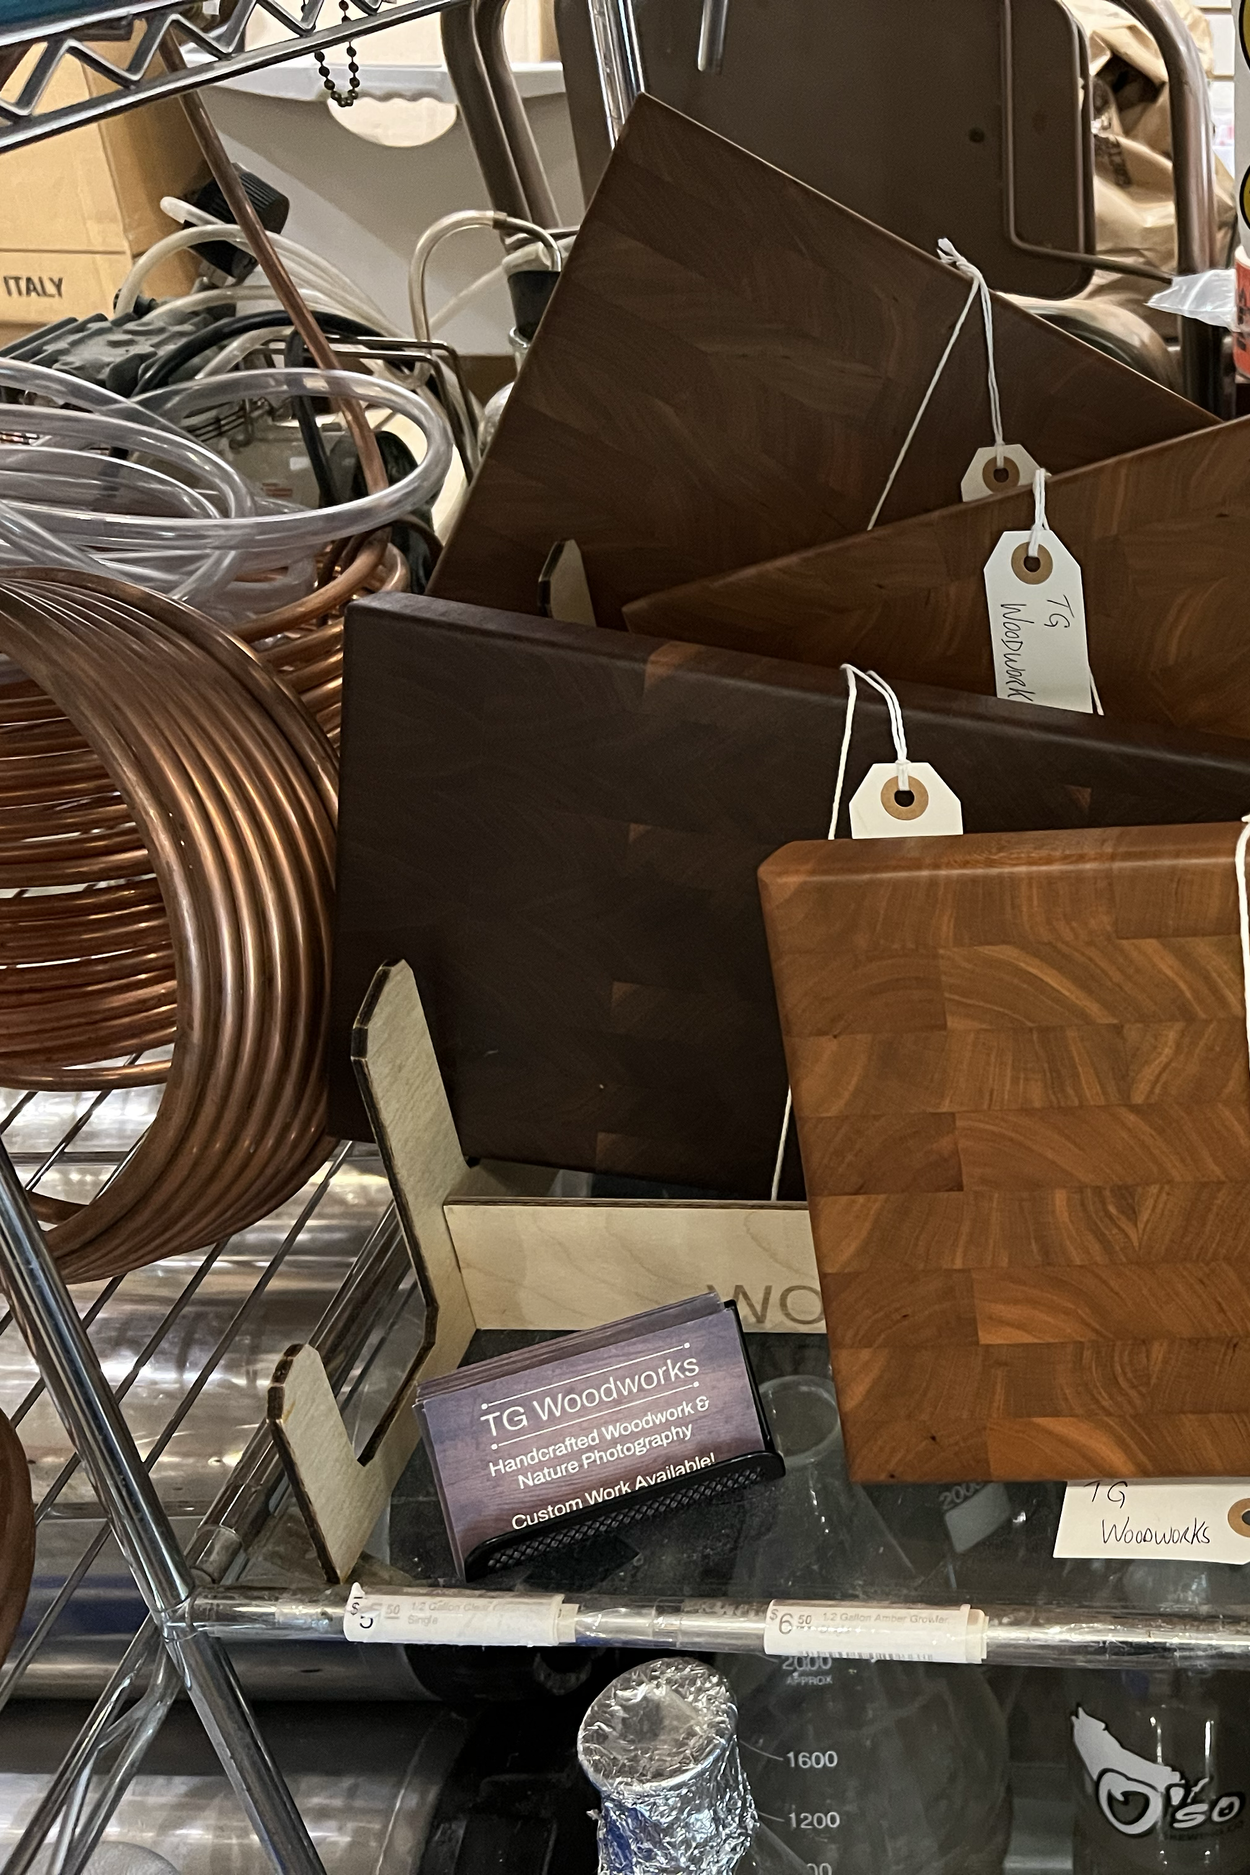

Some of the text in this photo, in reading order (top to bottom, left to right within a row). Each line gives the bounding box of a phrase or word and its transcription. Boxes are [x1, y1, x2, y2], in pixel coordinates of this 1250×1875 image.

[3, 276, 64, 299] ITALY
[1044, 594, 1075, 628] TG
[480, 1358, 700, 1437] TG Woodworks
[489, 1395, 710, 1477] Handcrafted Woodwork &
[518, 1424, 693, 1489] Nature Photography
[511, 1452, 716, 1530] Custom Work Available!
[1084, 1480, 1129, 1509] TG
[874, 1613, 907, 1624] Amber
[786, 1675, 833, 1685] APPROX
[786, 1750, 838, 1768] 1600
[789, 1811, 841, 1829] 1200
